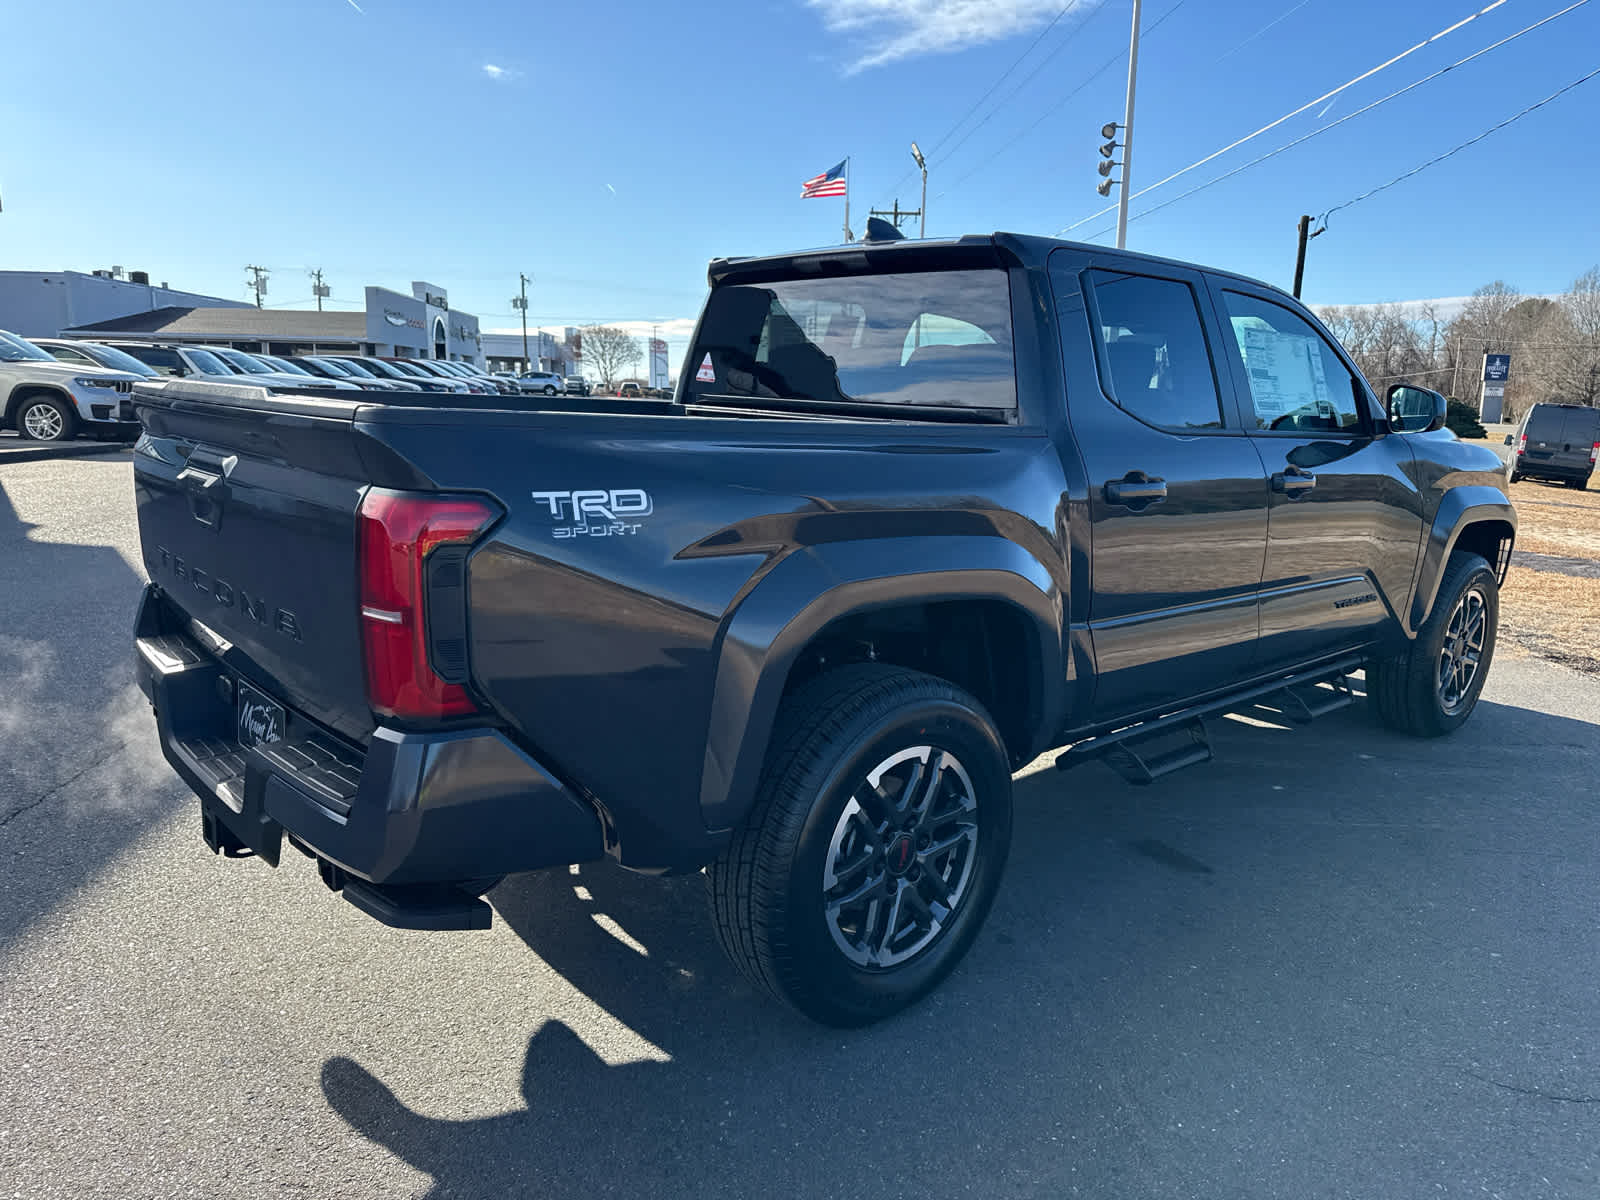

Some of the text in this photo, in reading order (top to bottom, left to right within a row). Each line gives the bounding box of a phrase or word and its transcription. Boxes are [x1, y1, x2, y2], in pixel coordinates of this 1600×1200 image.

[531, 488, 653, 522] TRD
[552, 521, 642, 538] SPORT
[156, 544, 304, 643] TACOMA
